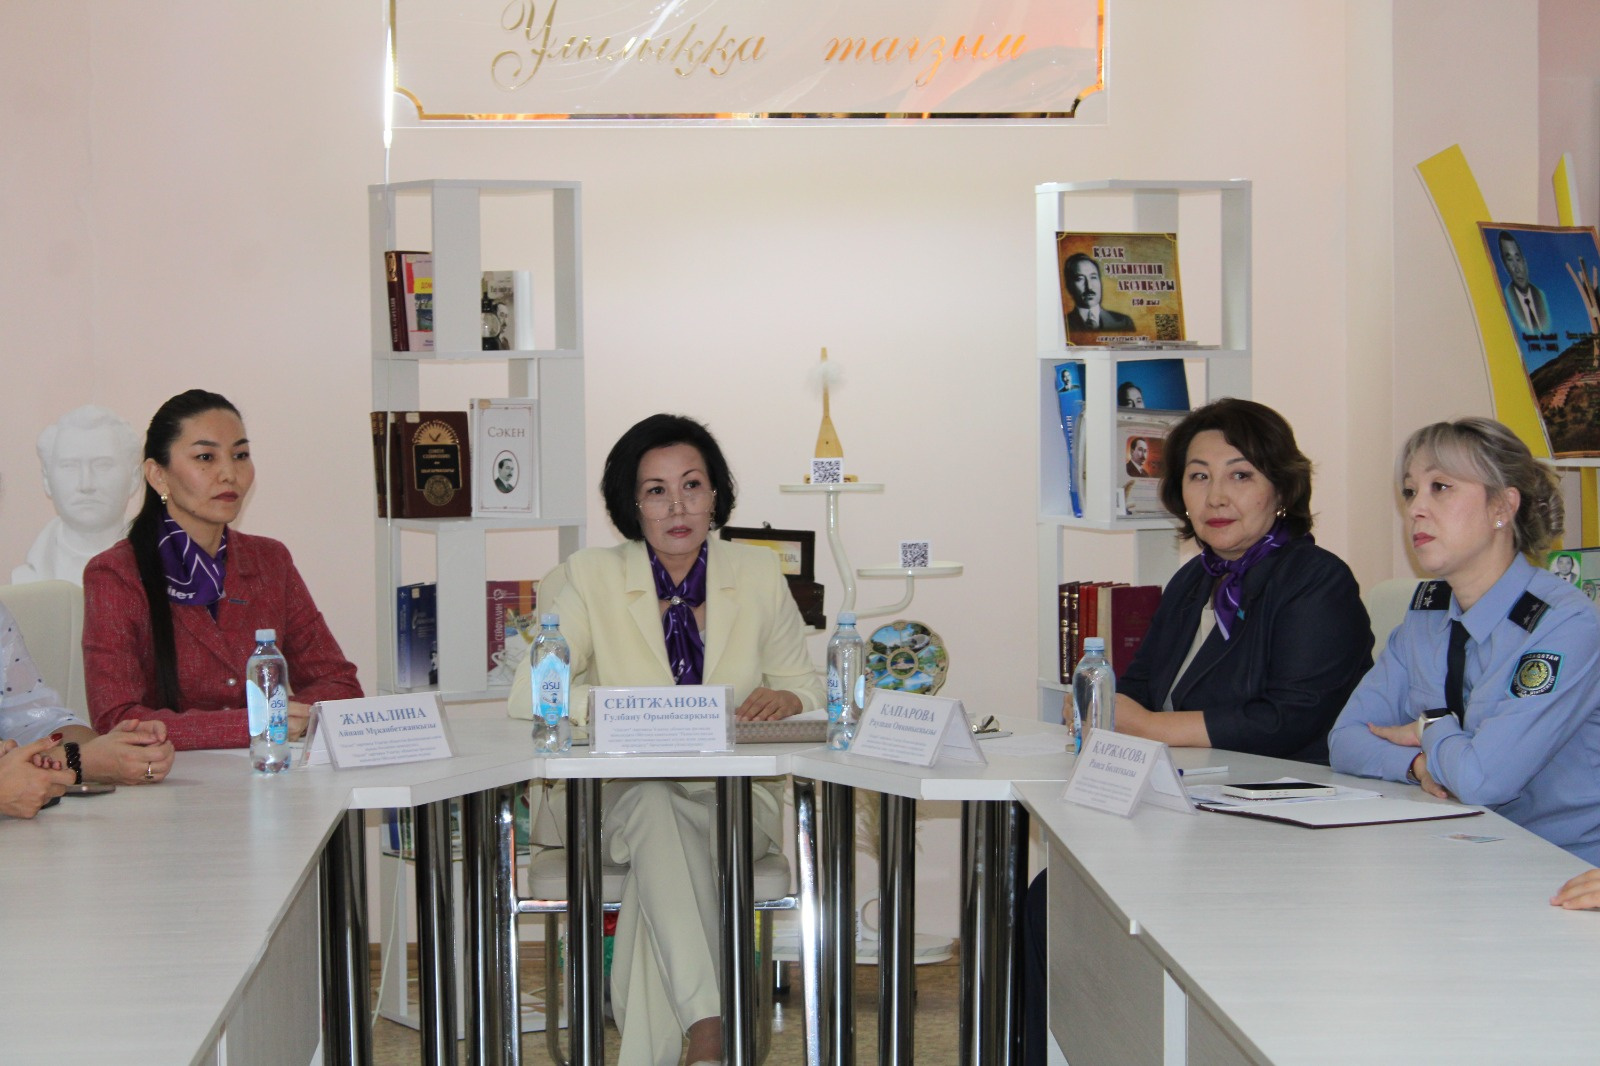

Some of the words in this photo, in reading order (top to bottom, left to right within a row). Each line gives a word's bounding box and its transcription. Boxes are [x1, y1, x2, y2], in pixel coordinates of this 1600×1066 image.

[542, 681, 560, 690] asu
[604, 695, 718, 710] СЕЙТЖАНОВА
[339, 707, 427, 726] ЖАНАЛИНА
